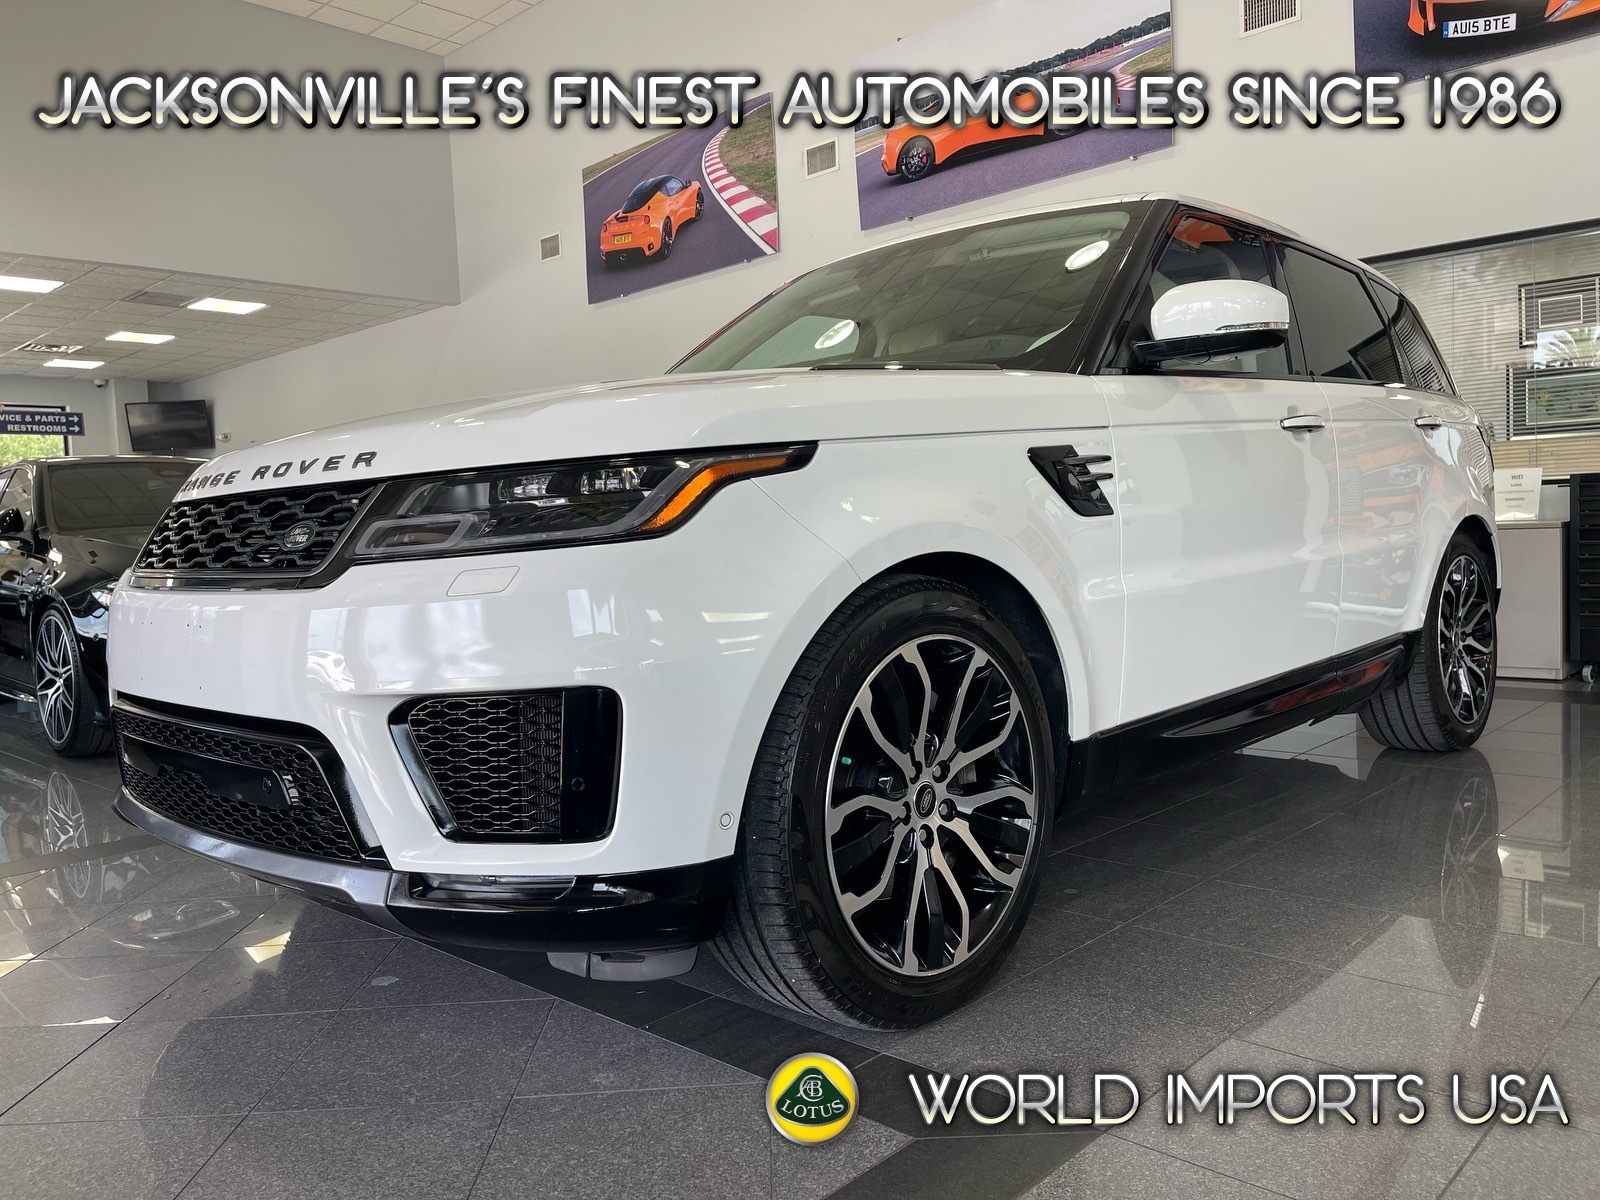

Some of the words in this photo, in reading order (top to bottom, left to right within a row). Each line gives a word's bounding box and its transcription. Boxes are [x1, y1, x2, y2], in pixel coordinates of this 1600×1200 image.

[1483, 16, 1511, 32] BTE
[35, 415, 66, 423] PARTS
[7, 424, 67, 433] RESTROOMS
[180, 470, 241, 493] RANGE
[251, 451, 378, 481] ROVER
